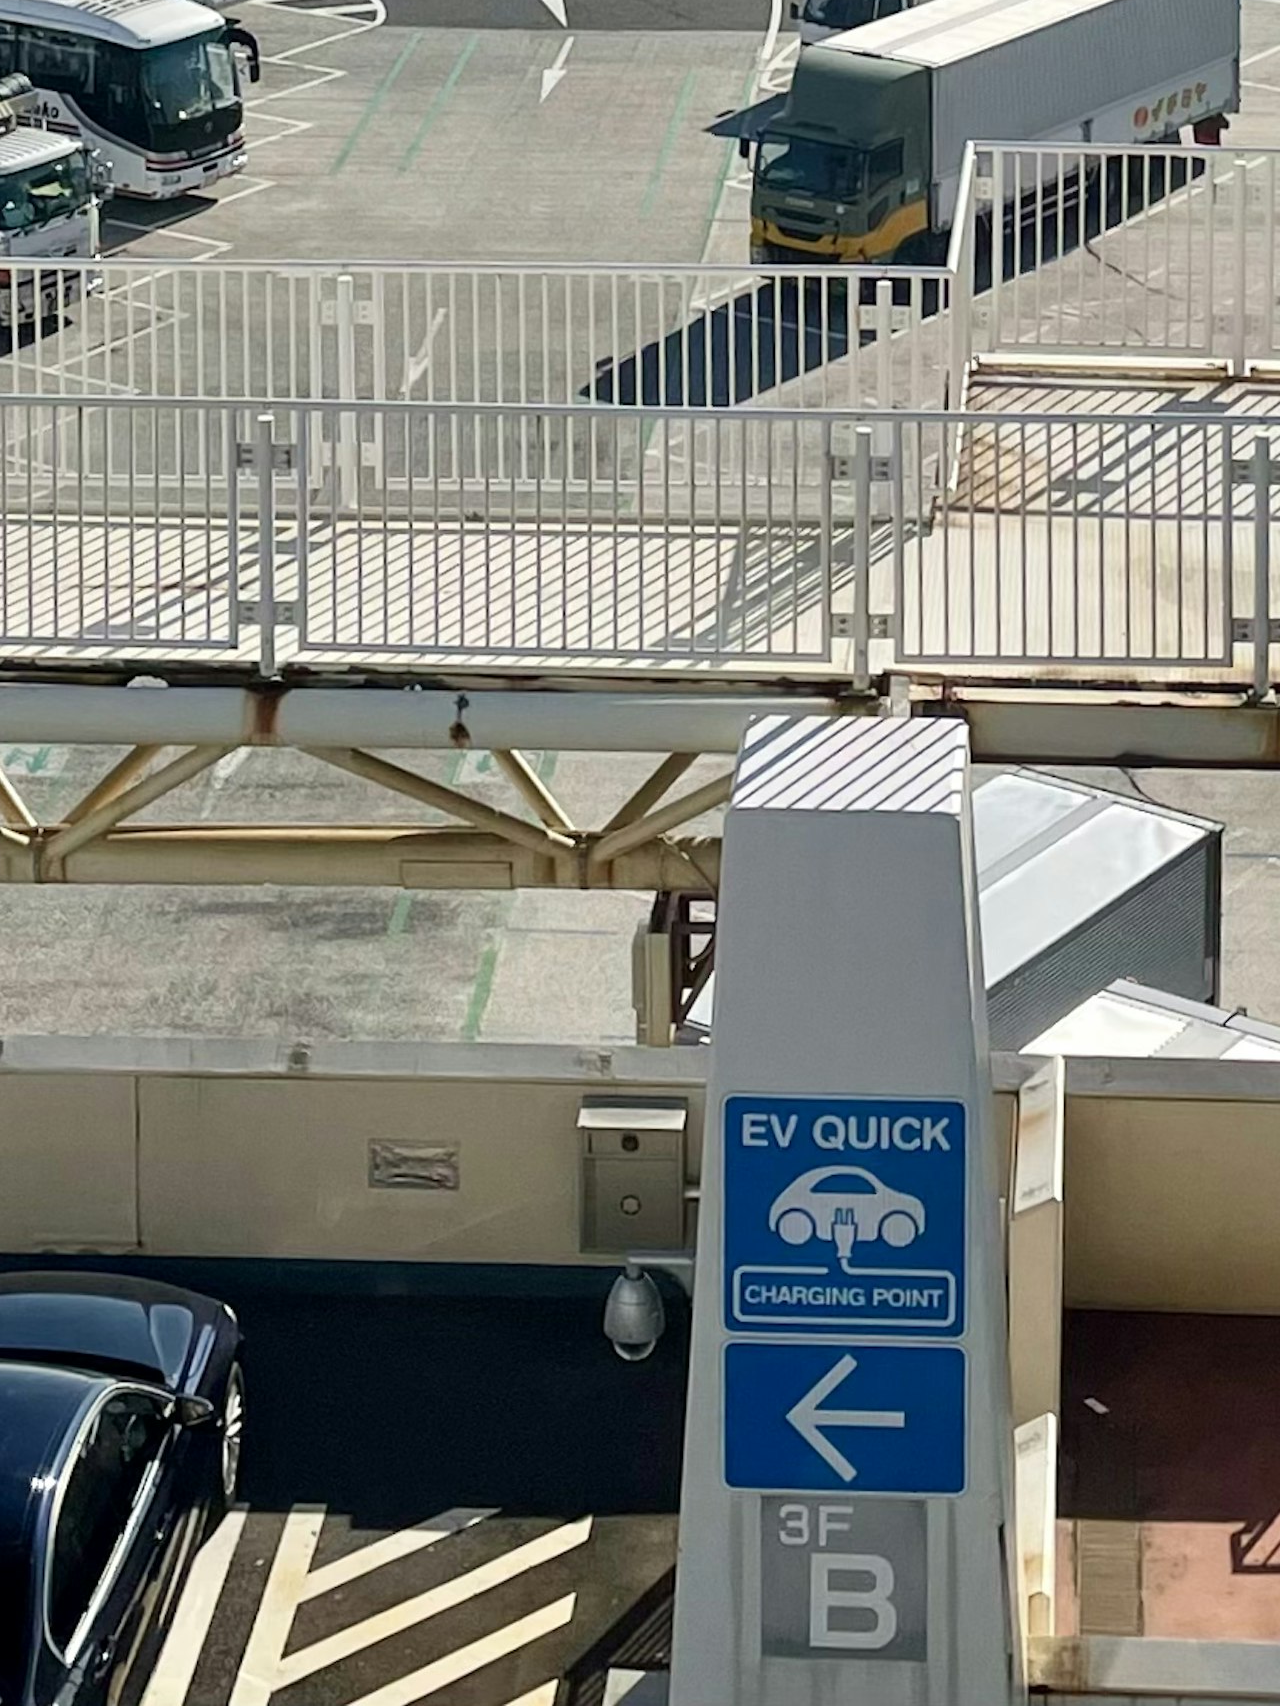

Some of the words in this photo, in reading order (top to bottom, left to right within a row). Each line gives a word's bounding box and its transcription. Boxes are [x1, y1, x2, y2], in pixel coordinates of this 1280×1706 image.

[741, 1113, 799, 1149] EV
[811, 1114, 952, 1153] QUICK
[744, 1284, 866, 1308] CHARGING
[871, 1287, 944, 1310] POINT
[777, 1504, 855, 1548] 3F
[808, 1552, 898, 1650] B
